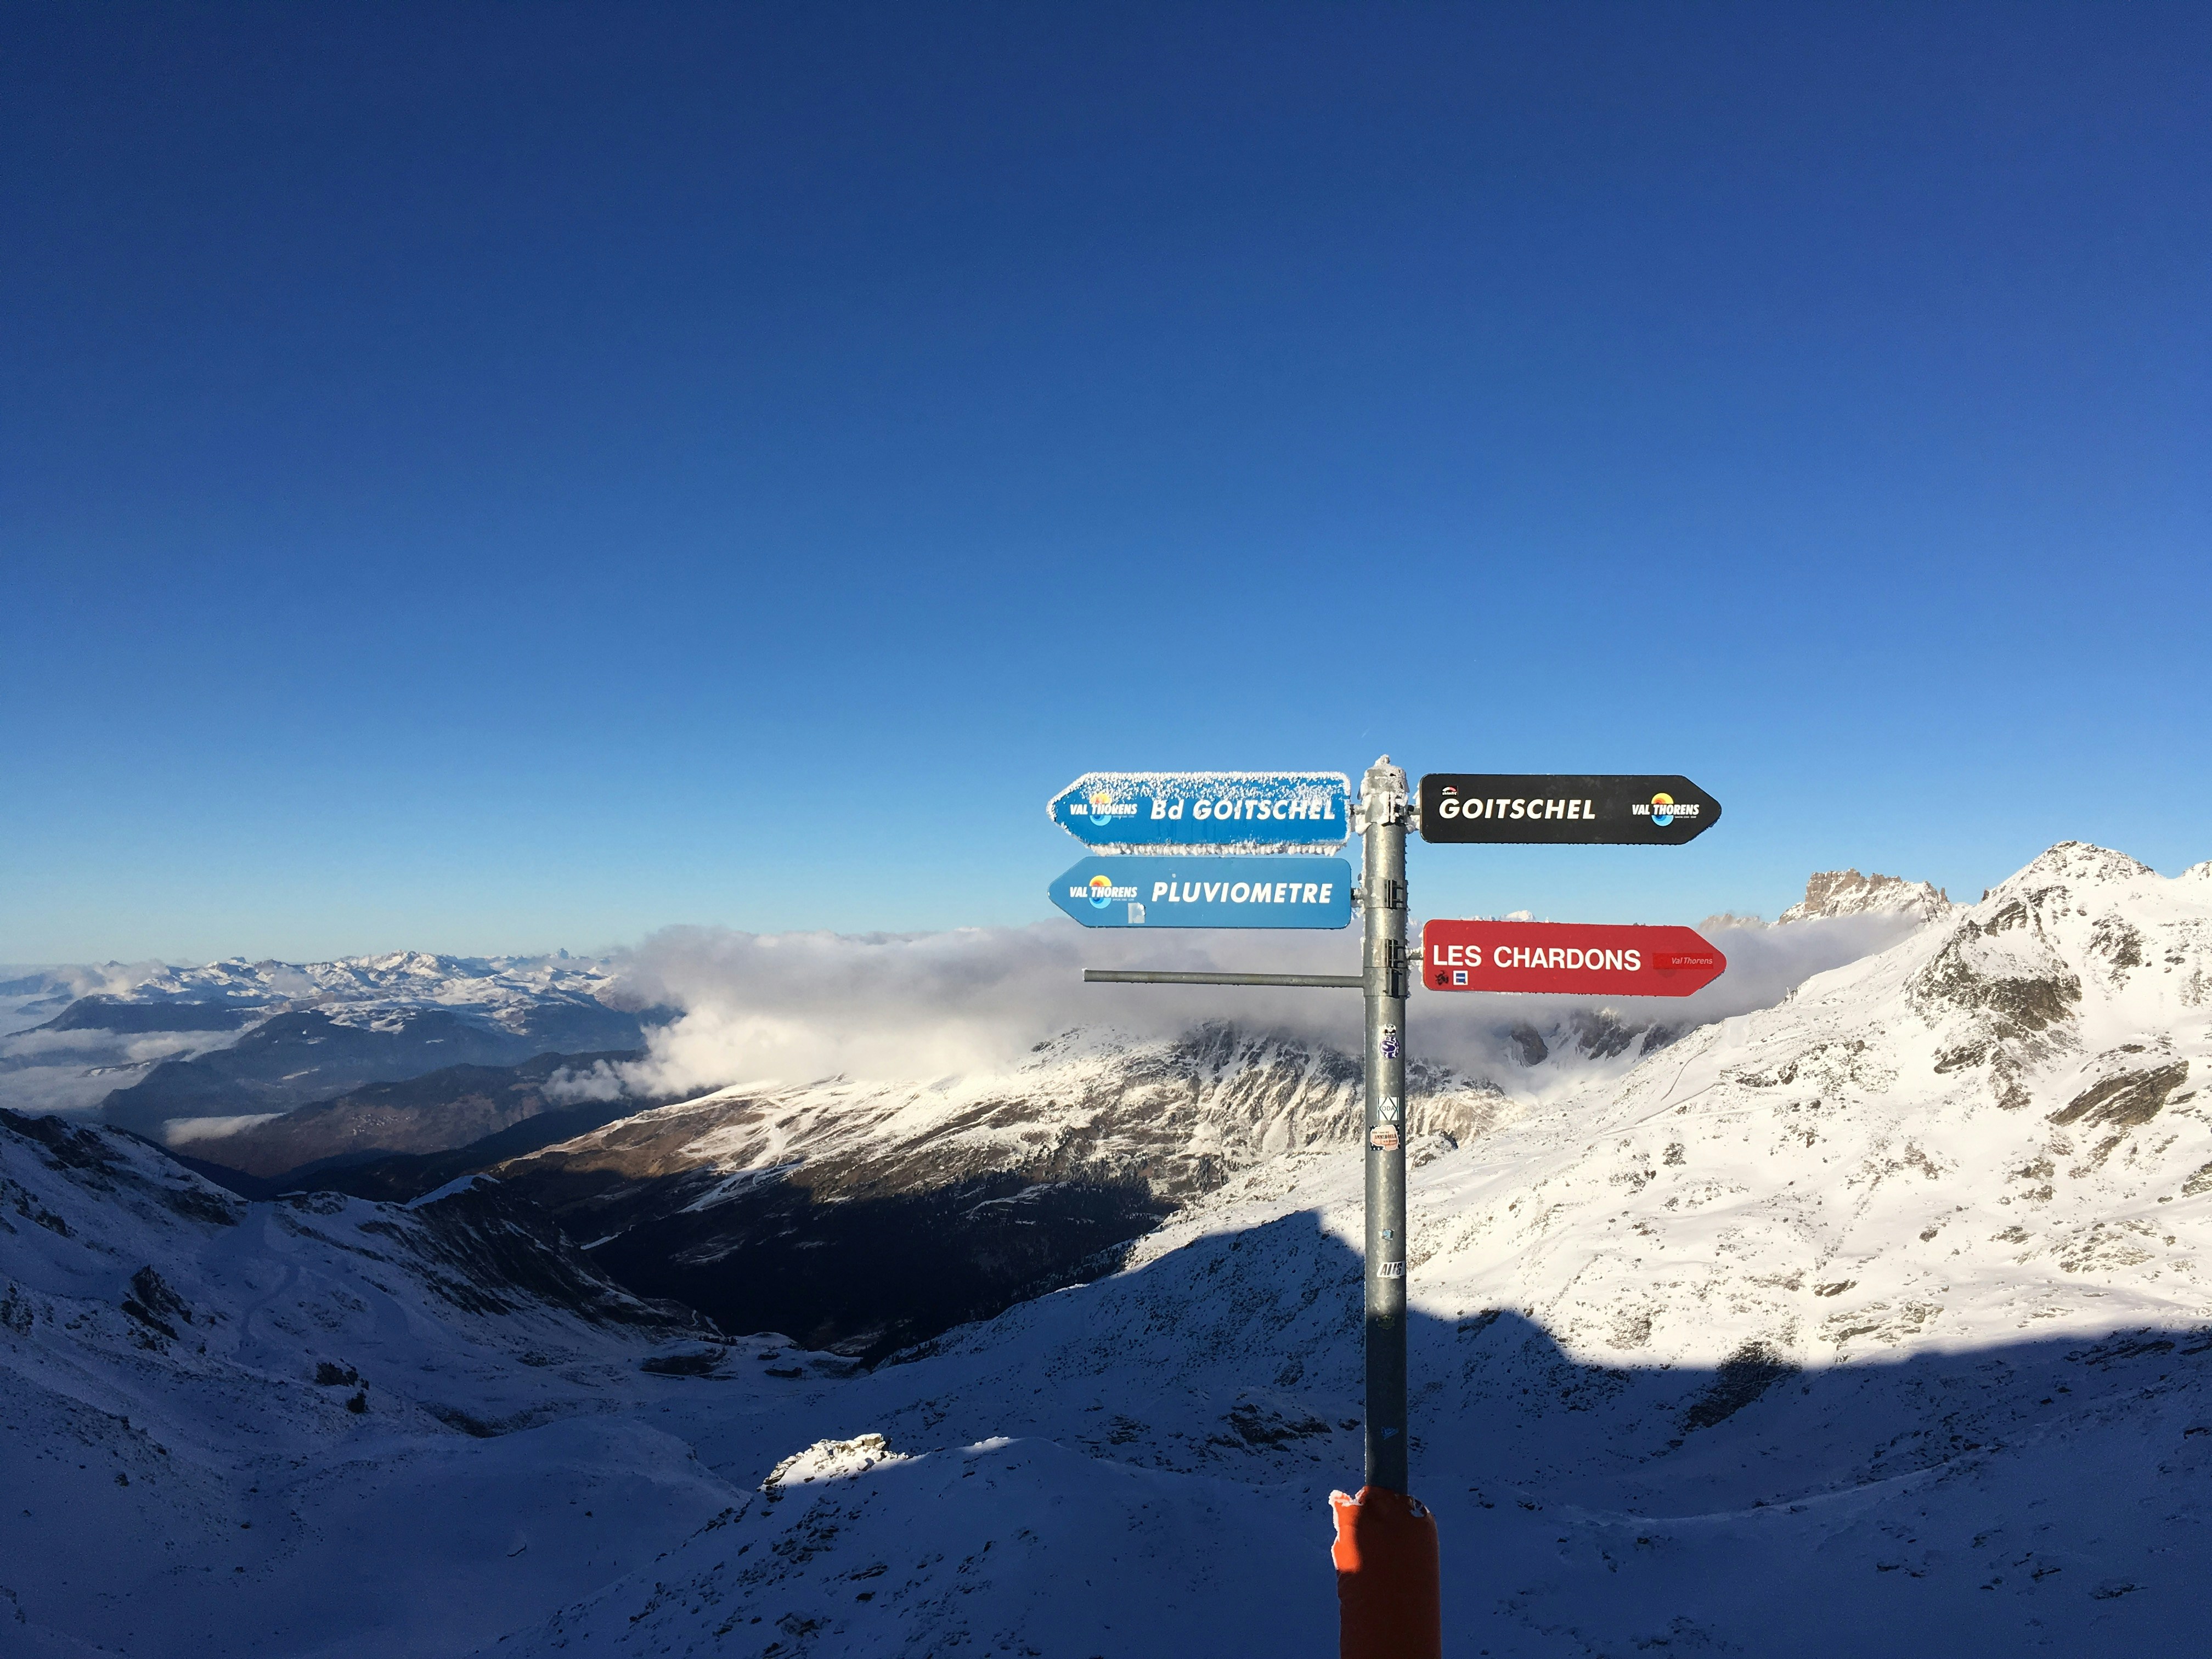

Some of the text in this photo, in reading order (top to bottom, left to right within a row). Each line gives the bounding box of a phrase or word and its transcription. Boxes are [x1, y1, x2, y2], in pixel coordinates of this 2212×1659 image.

[1070, 804, 1138, 815] VAL THORENS
[1150, 799, 1335, 820] Bd GOITSCHEL
[1438, 798, 1596, 820] GOITSCHEL
[1632, 804, 1700, 815] VAL THORENS
[1070, 887, 1138, 898] VAL THORENS
[1152, 882, 1333, 904] PLUVIOMETRE
[1433, 945, 1641, 971] LES CHARDONS
